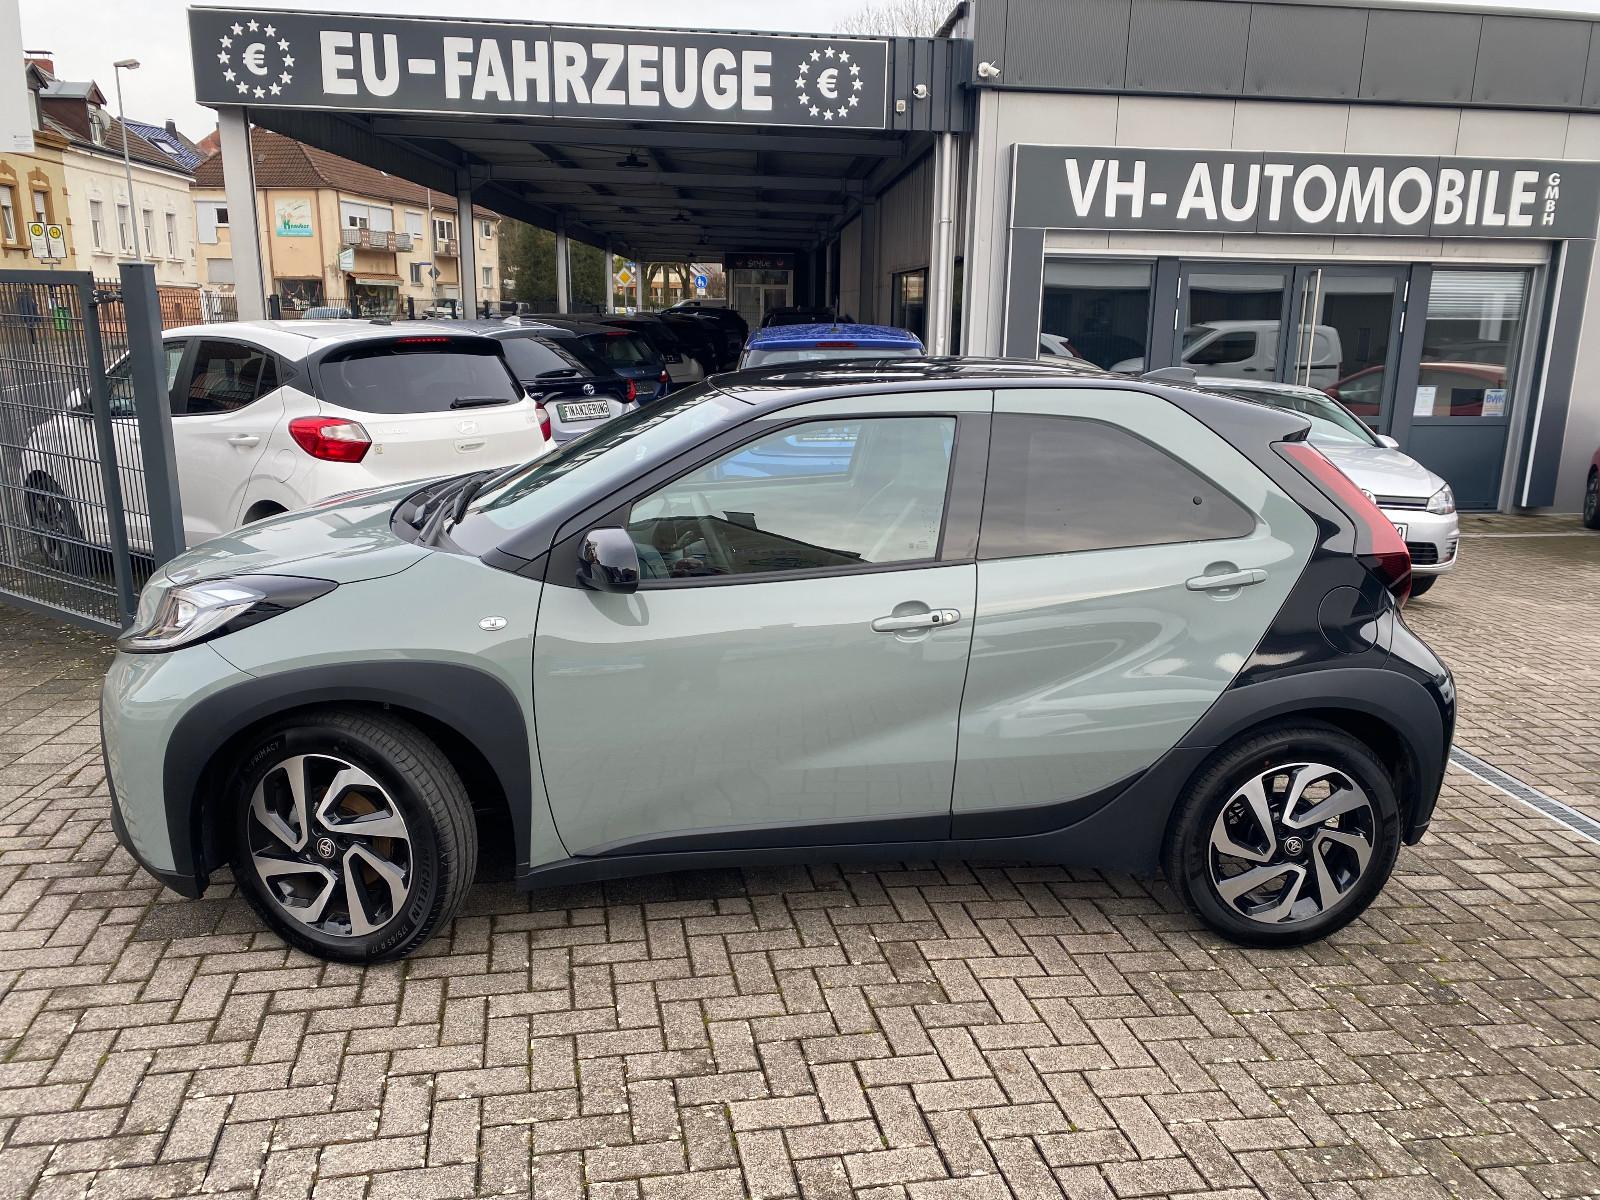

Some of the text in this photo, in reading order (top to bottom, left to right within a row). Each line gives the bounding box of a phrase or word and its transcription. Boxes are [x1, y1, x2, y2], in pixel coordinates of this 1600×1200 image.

[1543, 172, 1561, 226] GMBH
[564, 402, 609, 416] FINANZIERUNG
[412, 847, 431, 920] MICHELIN
